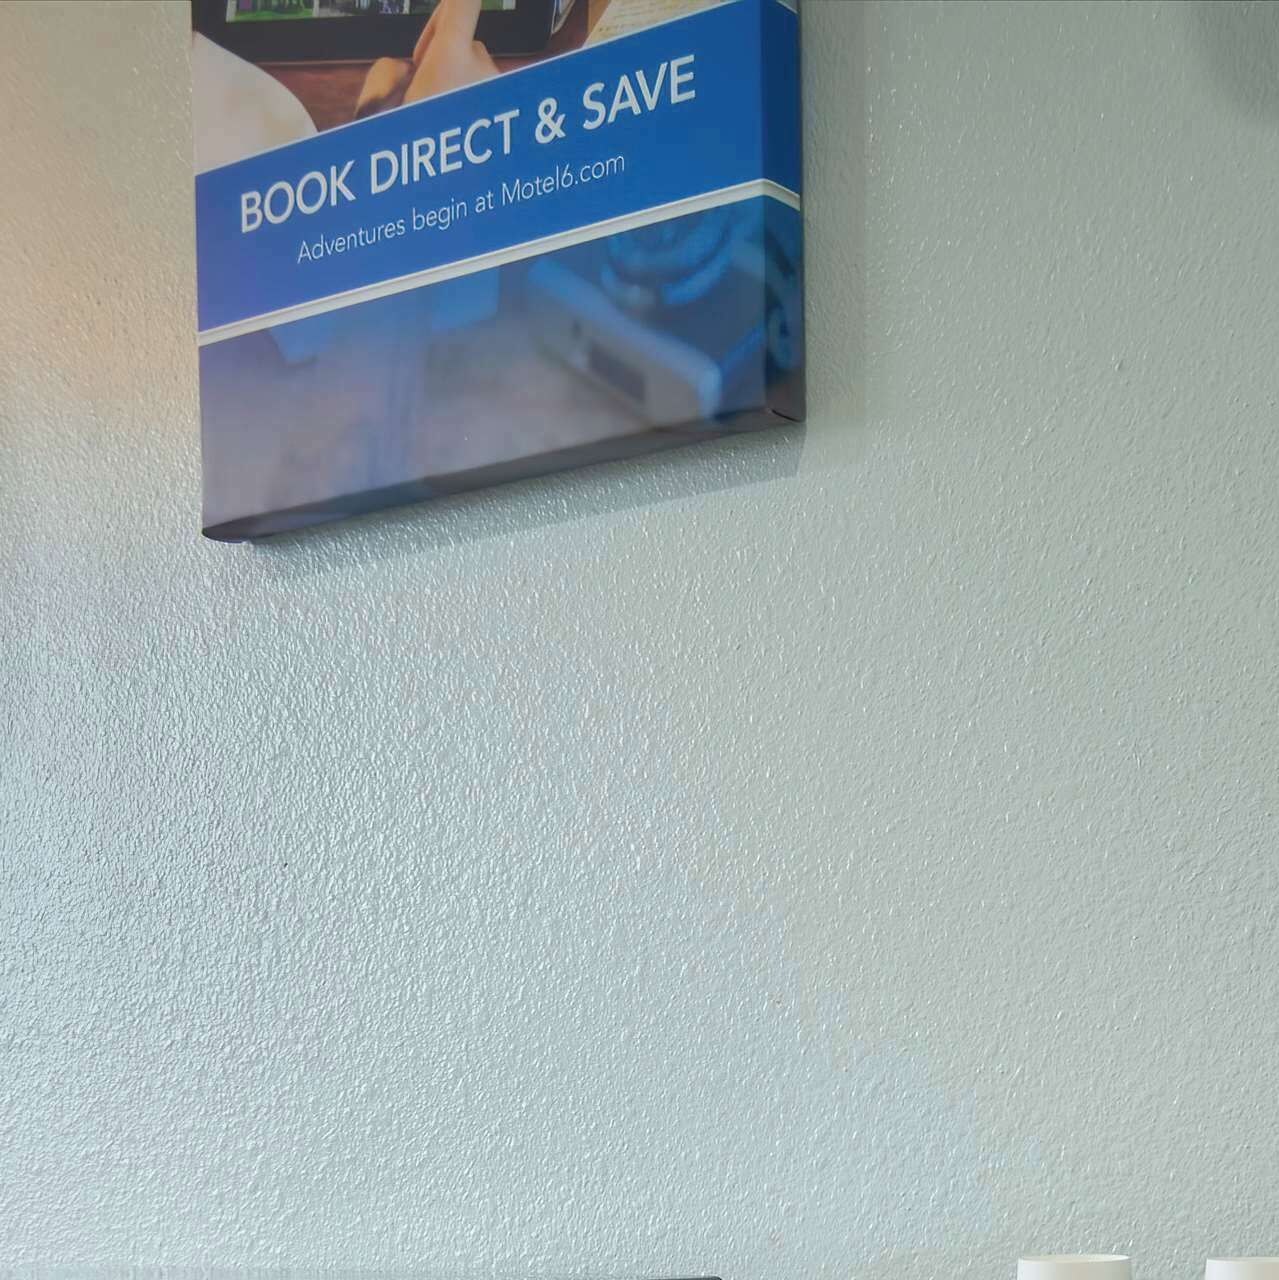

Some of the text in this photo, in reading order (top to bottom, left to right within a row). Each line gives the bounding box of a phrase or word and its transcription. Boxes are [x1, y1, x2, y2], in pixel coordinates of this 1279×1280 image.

[240, 54, 696, 234] BOOK DIRECT & SAVE
[297, 153, 625, 264] Adventures begin at Motel6.com
